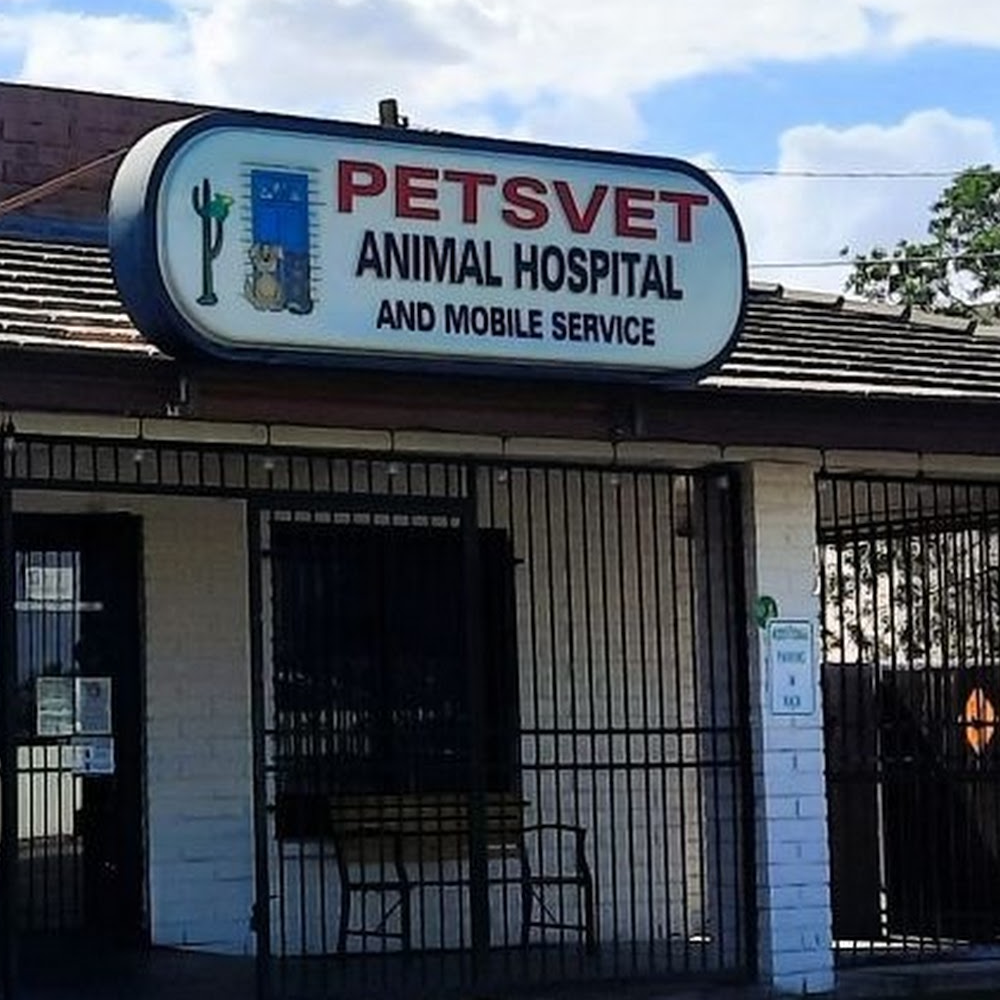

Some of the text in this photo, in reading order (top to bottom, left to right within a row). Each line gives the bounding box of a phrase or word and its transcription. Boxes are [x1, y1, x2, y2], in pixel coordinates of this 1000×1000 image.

[337, 158, 710, 243] PETSVET
[356, 230, 683, 300] ANIMAL HOSPITAL
[376, 300, 656, 346] AND MOBILE SERVICE
